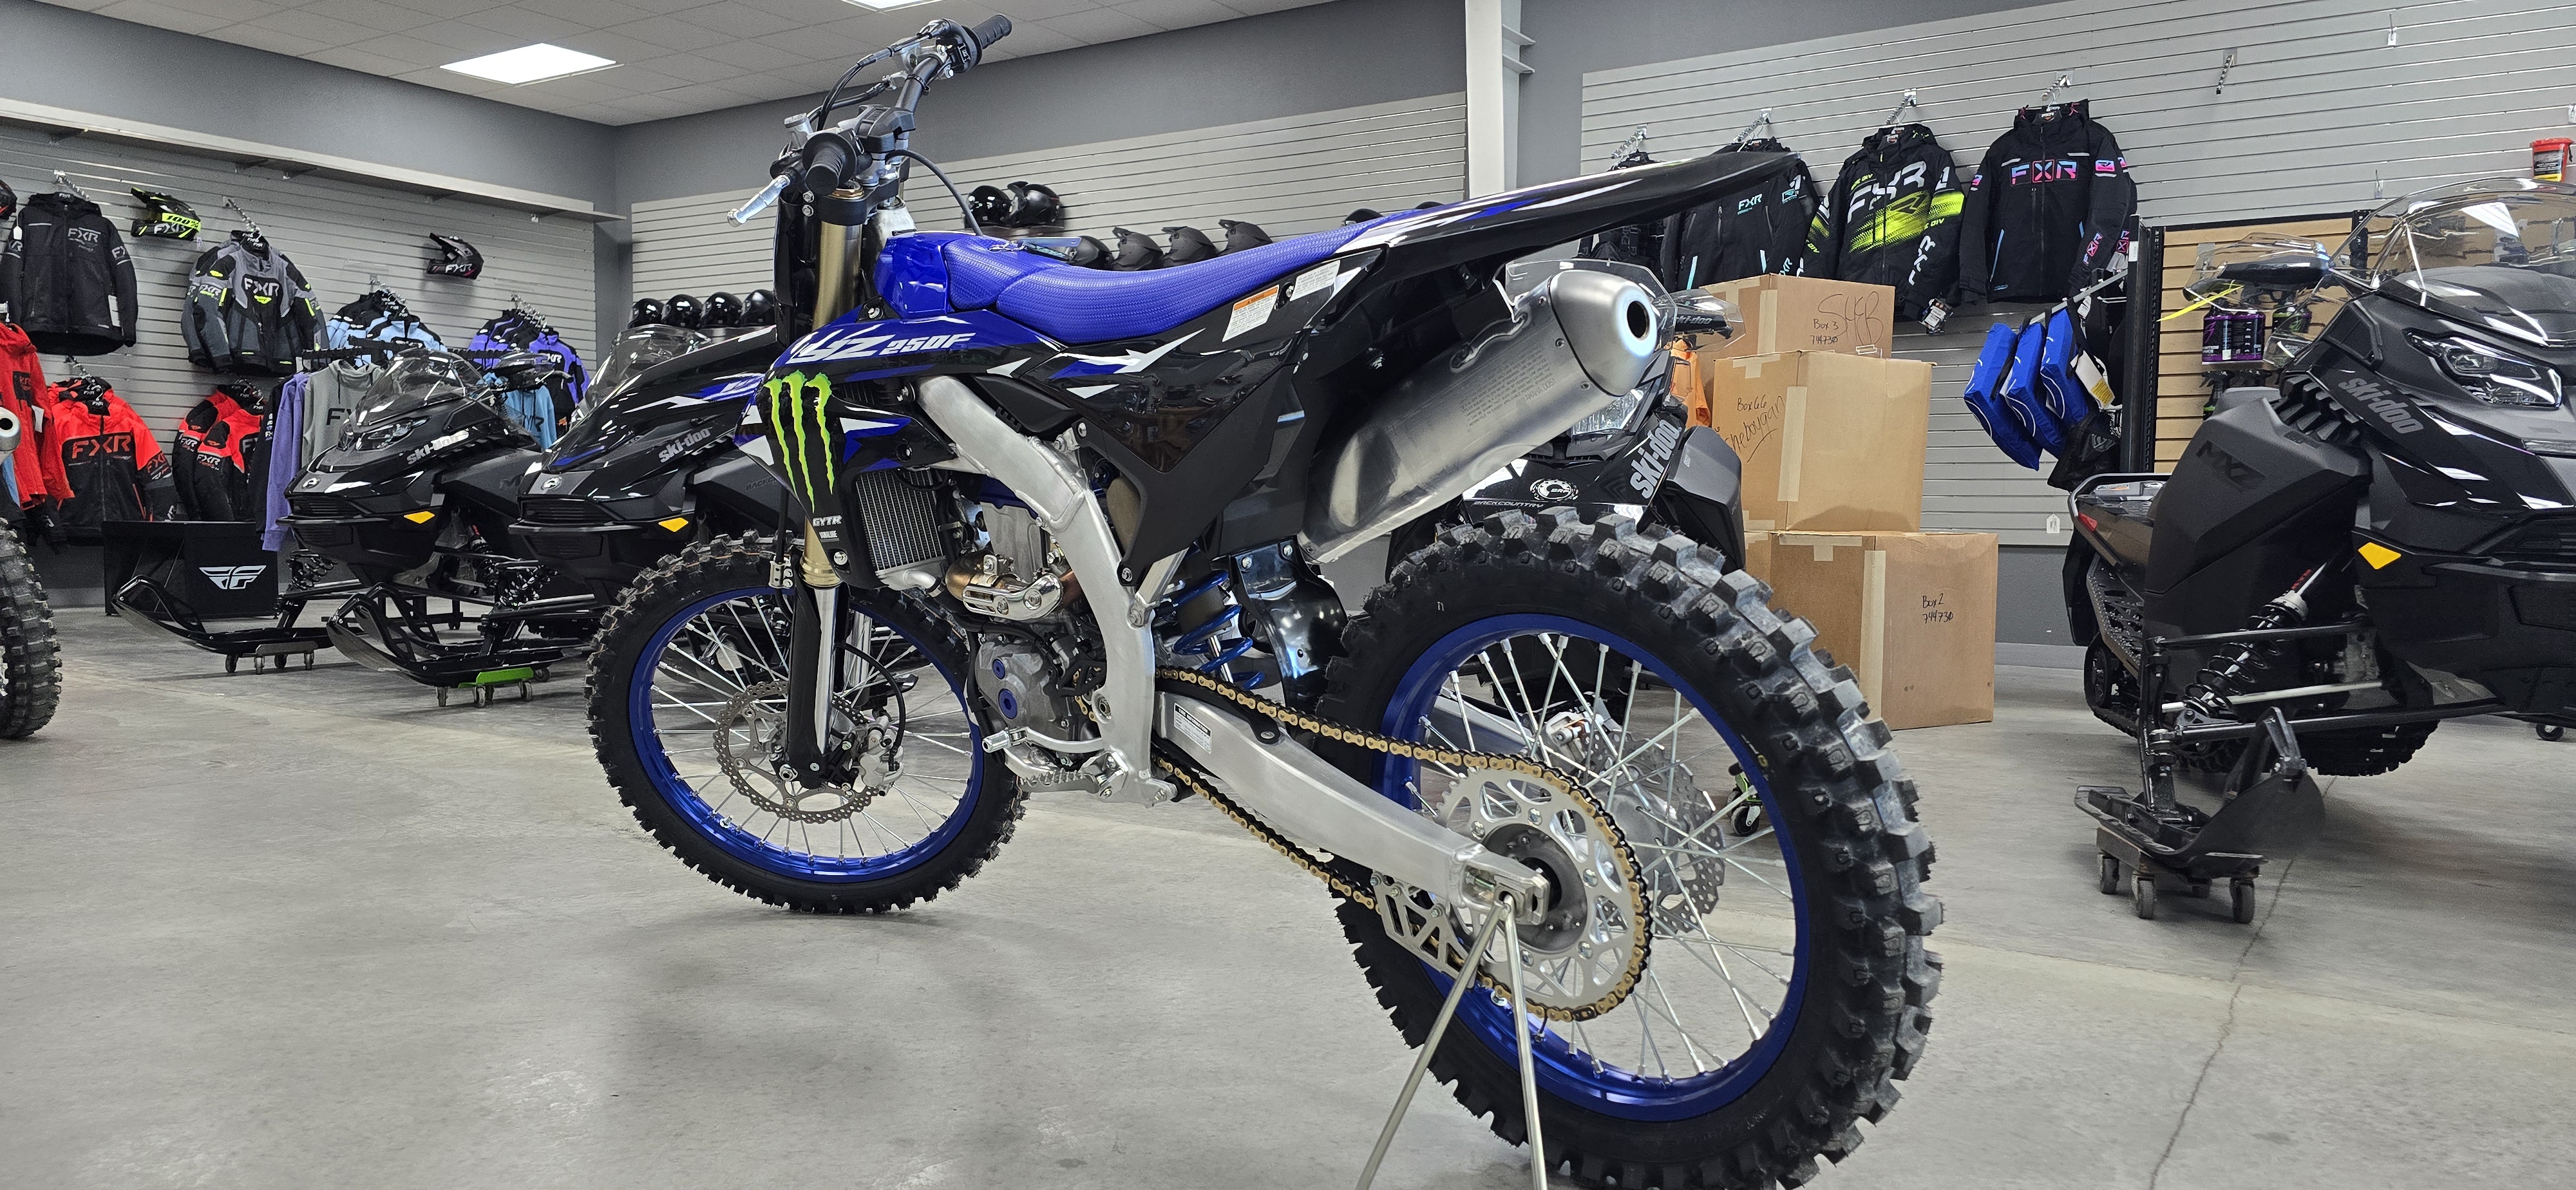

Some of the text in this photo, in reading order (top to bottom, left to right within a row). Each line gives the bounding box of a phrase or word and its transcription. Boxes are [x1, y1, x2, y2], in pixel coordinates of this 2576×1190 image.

[2011, 160, 2078, 186] FXR
[1847, 161, 1927, 224] FXR
[1738, 194, 1763, 211] FXR
[153, 222, 187, 234] FXR
[166, 214, 200, 229] 100%
[1930, 218, 1945, 227] DIV
[68, 227, 99, 243] FXR
[2083, 231, 2103, 266] FXR
[445, 263, 473, 274] FXR
[199, 284, 222, 296] FXR
[243, 277, 280, 297] FXR
[1813, 318, 1839, 330] Box 3
[879, 332, 976, 356] 250F
[1737, 397, 1752, 411] Box
[2338, 378, 2424, 434] ski-doo
[1724, 395, 1786, 454] heboygan
[71, 435, 131, 459] FXR
[658, 428, 711, 464] ski-doo
[196, 453, 222, 466] FXR
[1630, 419, 1680, 500] ski-doo
[812, 515, 842, 527] GYTR
[1922, 592, 1945, 609] Box 2
[1922, 609, 1954, 625] 744730
